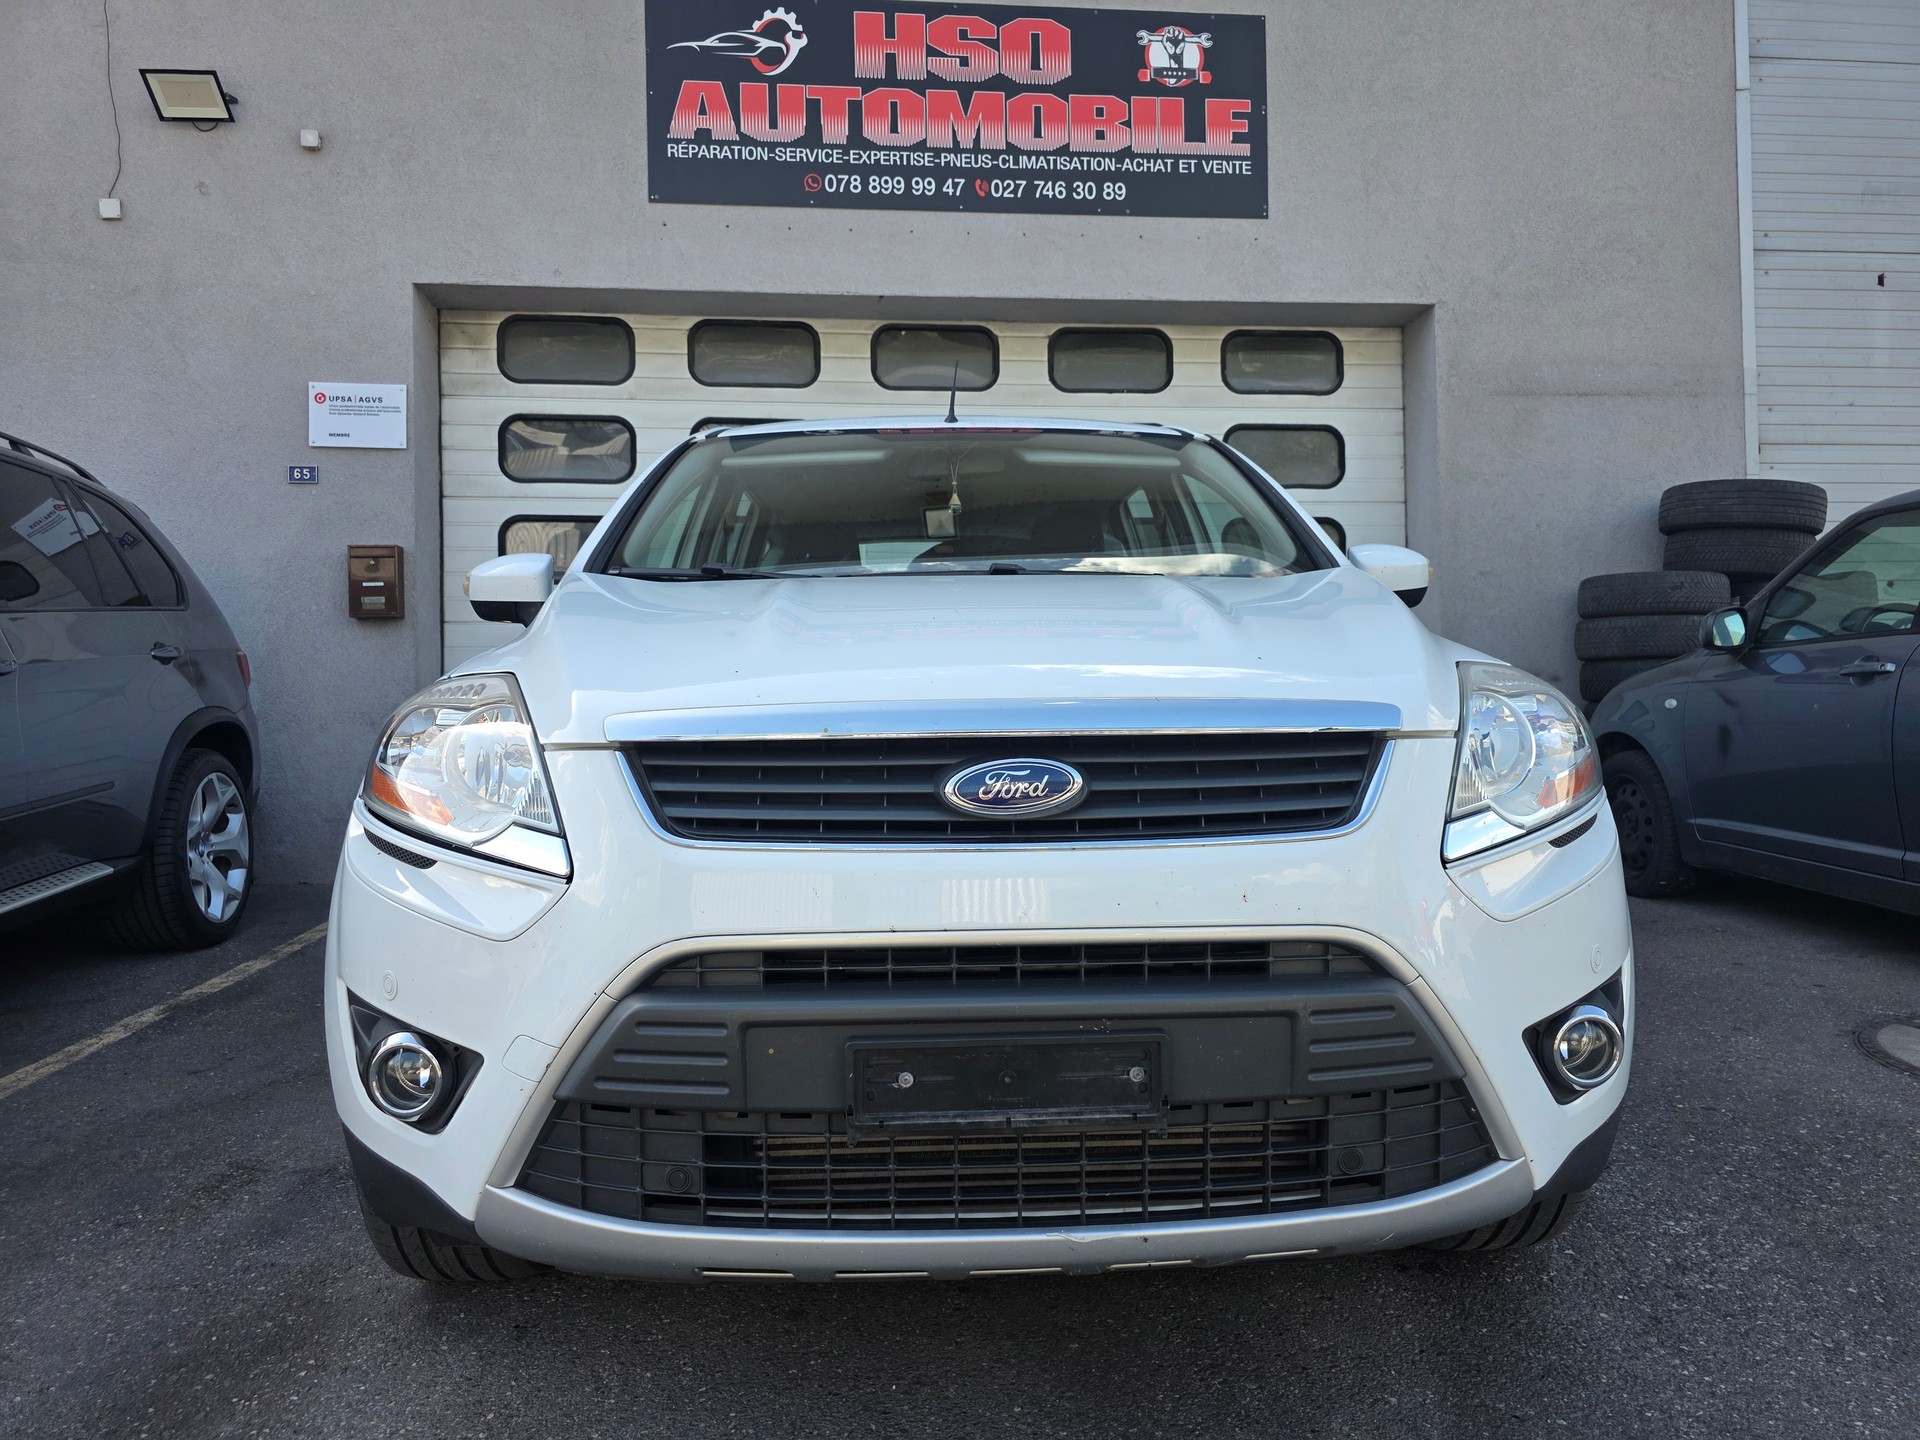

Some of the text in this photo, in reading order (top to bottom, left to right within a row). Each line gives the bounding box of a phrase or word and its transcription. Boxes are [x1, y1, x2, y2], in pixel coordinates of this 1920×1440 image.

[854, 11, 1072, 85] HSO
[667, 80, 1251, 156] AUTOMOBILE
[1179, 160, 1198, 173] ET
[1202, 160, 1252, 175] VENTE
[824, 174, 1126, 201] 078 899 99 47 027 746 30 89
[294, 468, 310, 479] 65
[978, 769, 1049, 801] Ford
